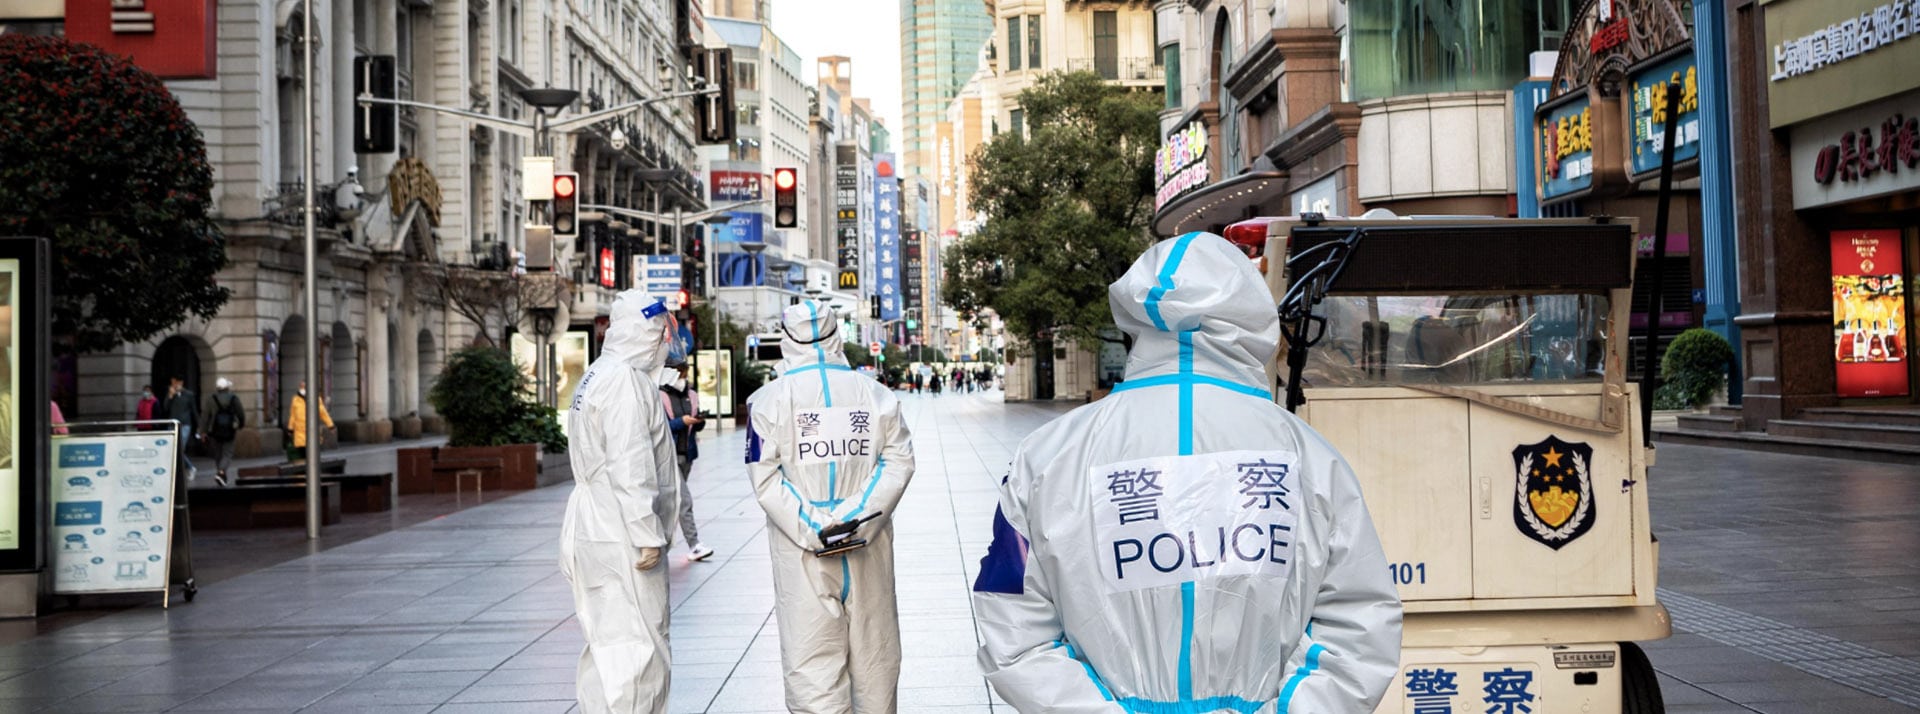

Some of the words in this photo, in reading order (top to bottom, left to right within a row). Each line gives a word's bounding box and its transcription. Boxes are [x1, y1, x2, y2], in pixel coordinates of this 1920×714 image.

[719, 176, 745, 186] HAPPY
[798, 412, 821, 437] 警
[849, 410, 870, 434] 察
[798, 439, 870, 460] POLICE
[1107, 467, 1164, 525] 警
[1237, 458, 1291, 510] 察
[1113, 523, 1291, 579] POLICE
[1389, 562, 1426, 585] 101
[1405, 668, 1459, 714] 警
[1482, 667, 1535, 714] 察
